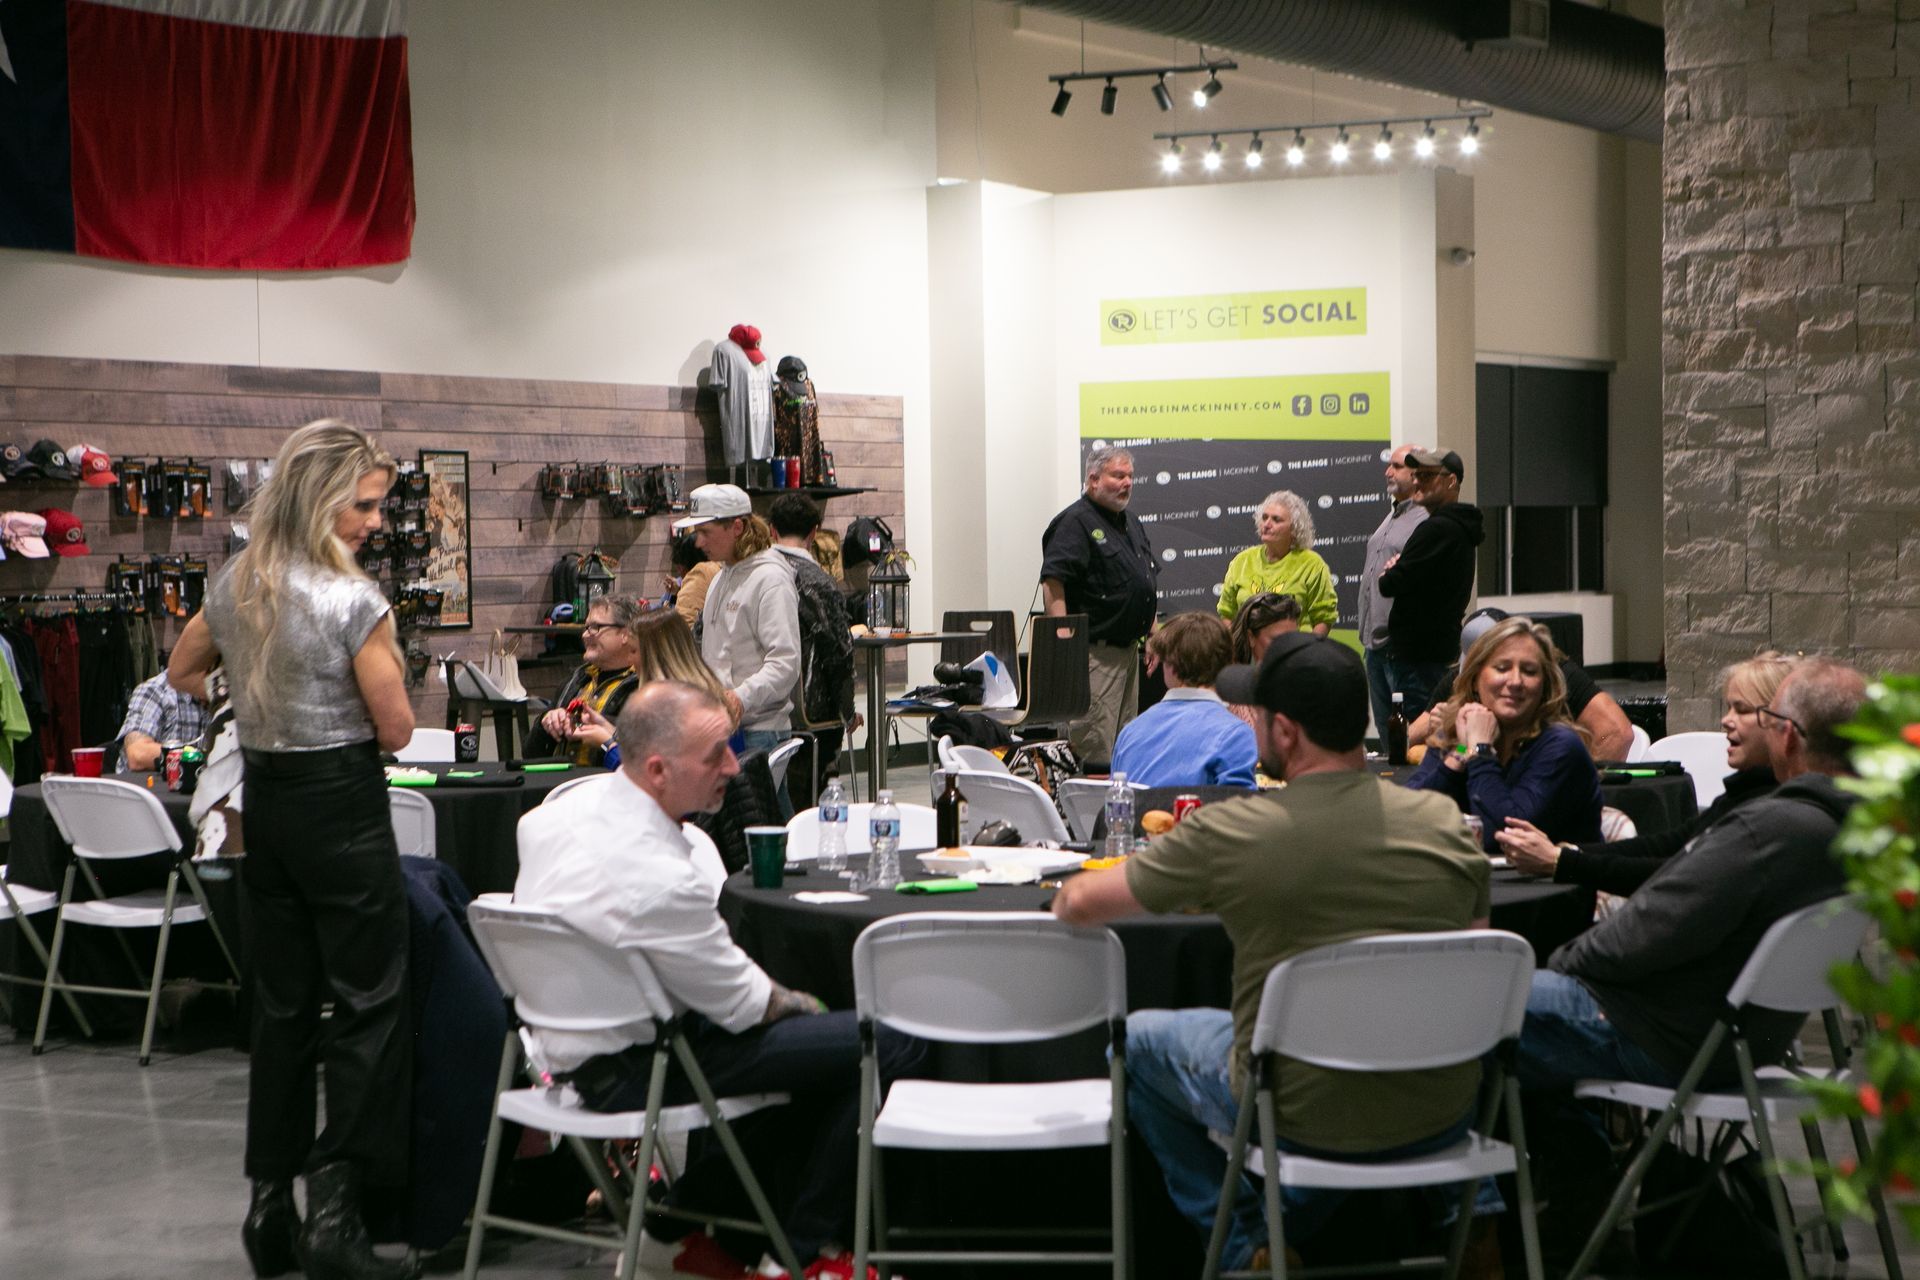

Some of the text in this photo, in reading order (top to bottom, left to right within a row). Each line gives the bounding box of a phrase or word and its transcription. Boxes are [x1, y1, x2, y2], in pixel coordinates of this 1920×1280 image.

[1144, 307, 1198, 331] LET'S
[1207, 304, 1252, 328] GET
[1262, 301, 1358, 325] SOCIAL
[1101, 401, 1281, 415] THERANGEINMCKINNEY.COM
[1113, 439, 1126, 448] THE
[1127, 437, 1152, 447] RANGE
[1288, 454, 1372, 470] THE RANGE MCKINNEY
[1177, 465, 1260, 481] THE RANGE MCKINNEY
[1339, 496, 1352, 505] THE
[1354, 494, 1380, 503] RANGE
[1138, 510, 1200, 522] ANGE MCKINNEY
[1227, 506, 1240, 515] THE
[1313, 536, 1334, 546] ANGE
[1184, 549, 1197, 558] THE
[1198, 547, 1223, 557] RANGE
[1345, 575, 1359, 584] THE
[1170, 587, 1206, 597] MCKINNEY
